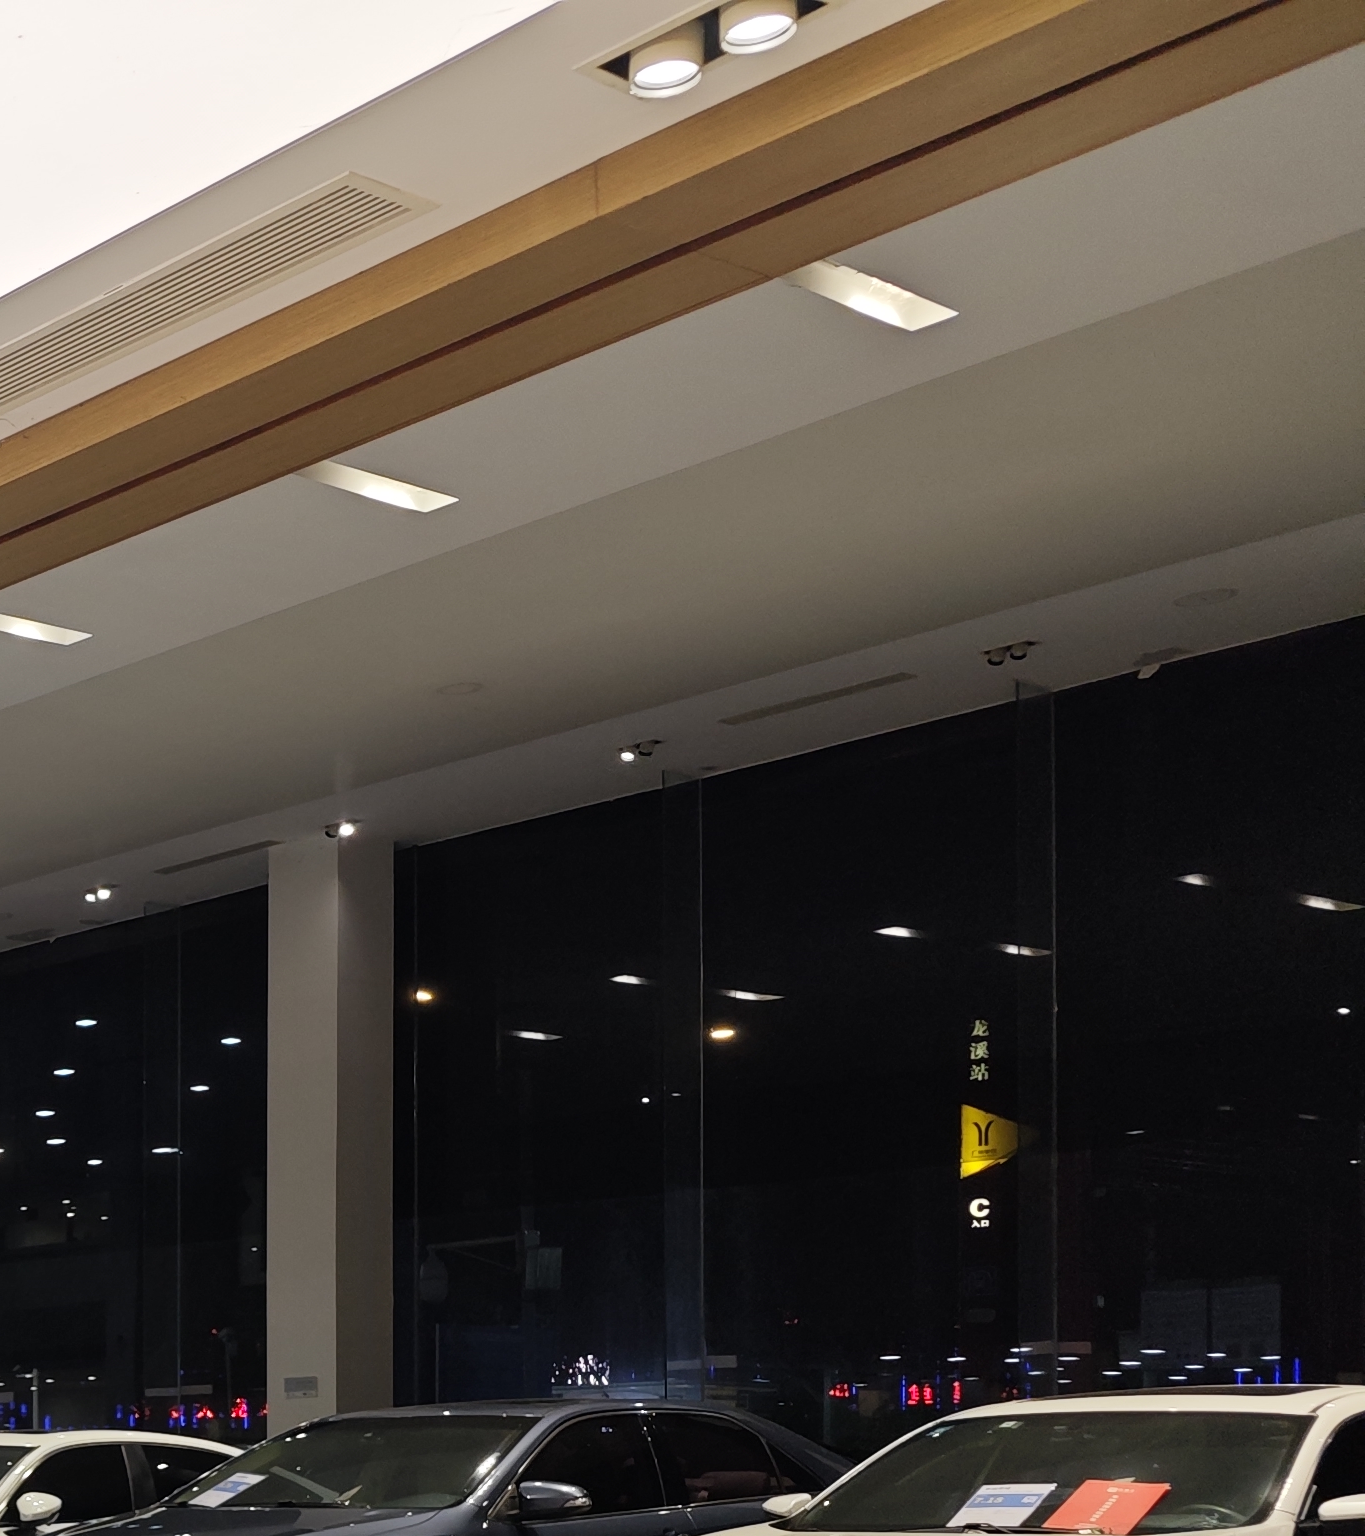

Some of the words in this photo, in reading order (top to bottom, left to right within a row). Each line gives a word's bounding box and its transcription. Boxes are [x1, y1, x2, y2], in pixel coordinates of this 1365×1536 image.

[969, 1019, 989, 1081] 龙溪站
[969, 1197, 990, 1218] C
[971, 1219, 990, 1228] 入口
